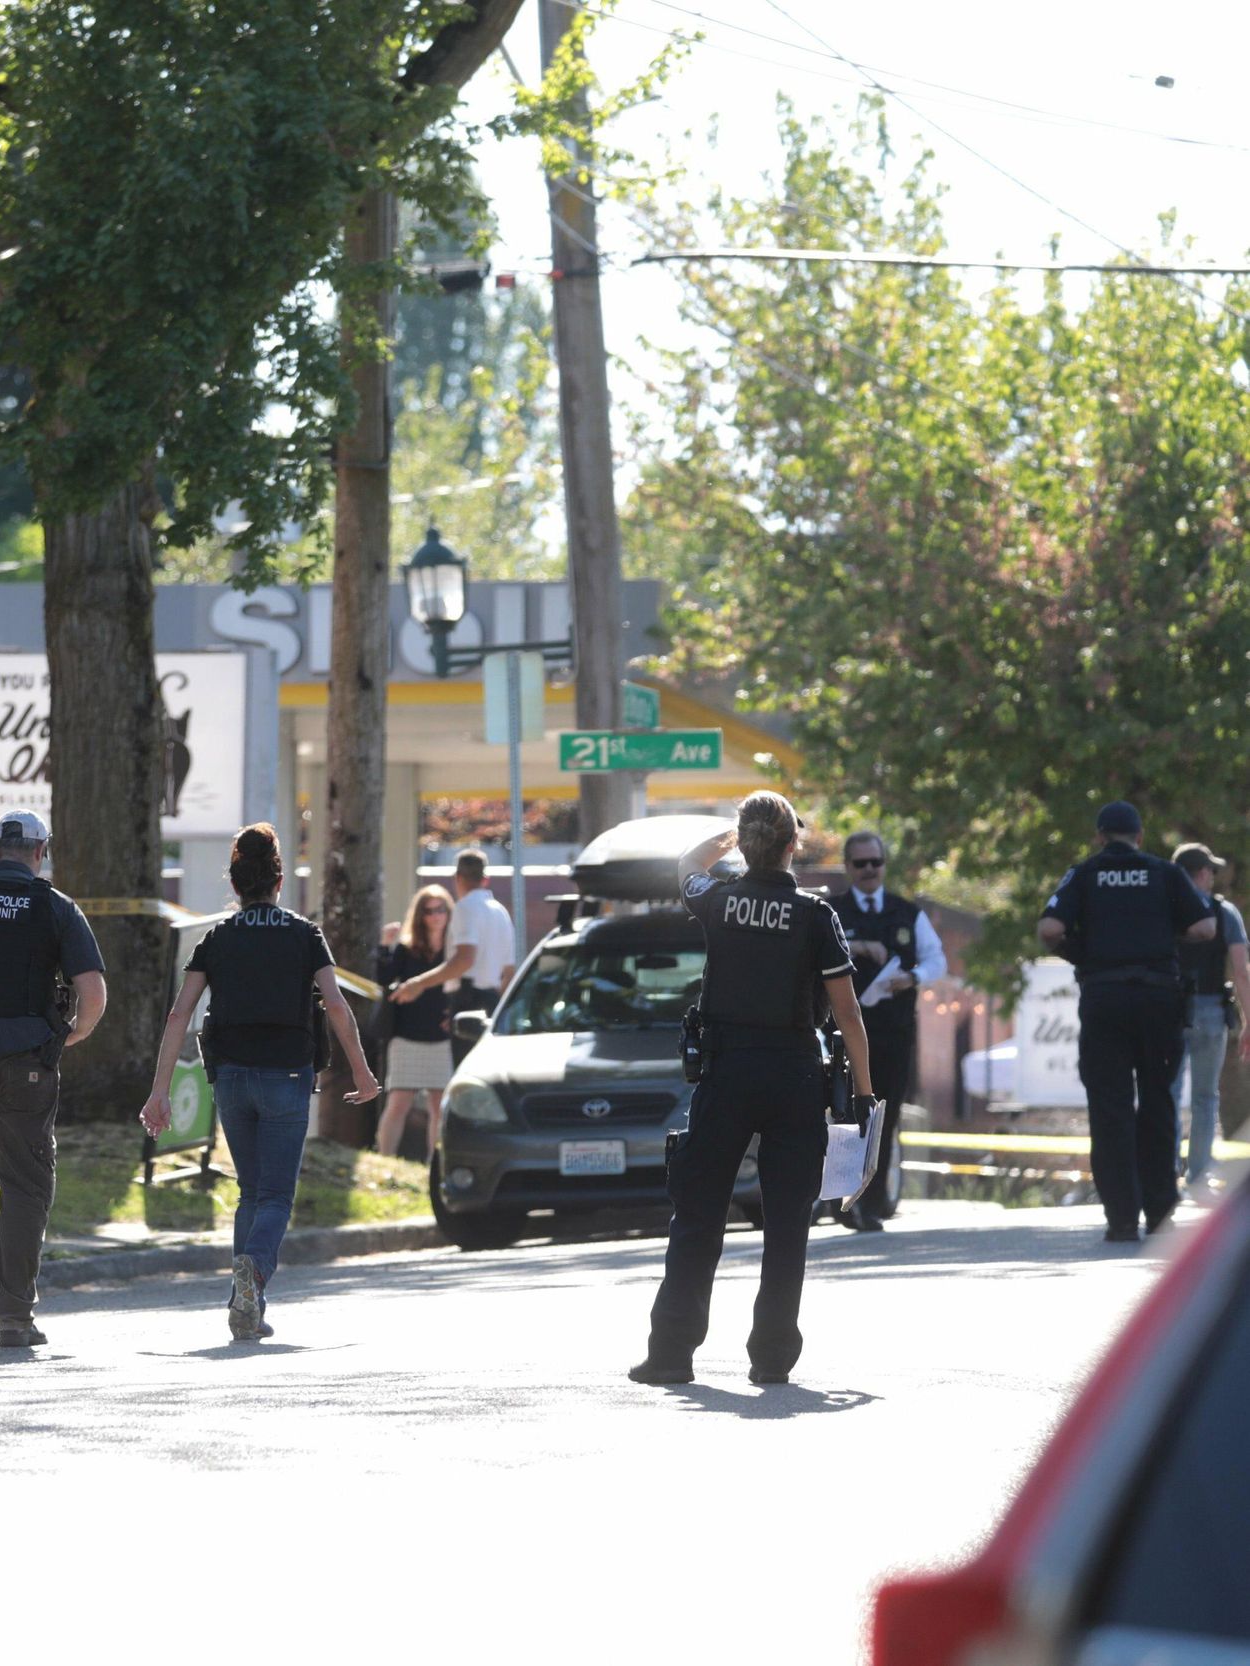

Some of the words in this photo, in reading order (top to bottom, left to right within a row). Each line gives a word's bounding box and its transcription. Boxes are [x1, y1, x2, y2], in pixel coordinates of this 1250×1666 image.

[670, 741, 712, 762] Ave
[1097, 870, 1149, 887] POLICE
[234, 907, 290, 926] POLICE
[724, 896, 792, 930] POLICE
